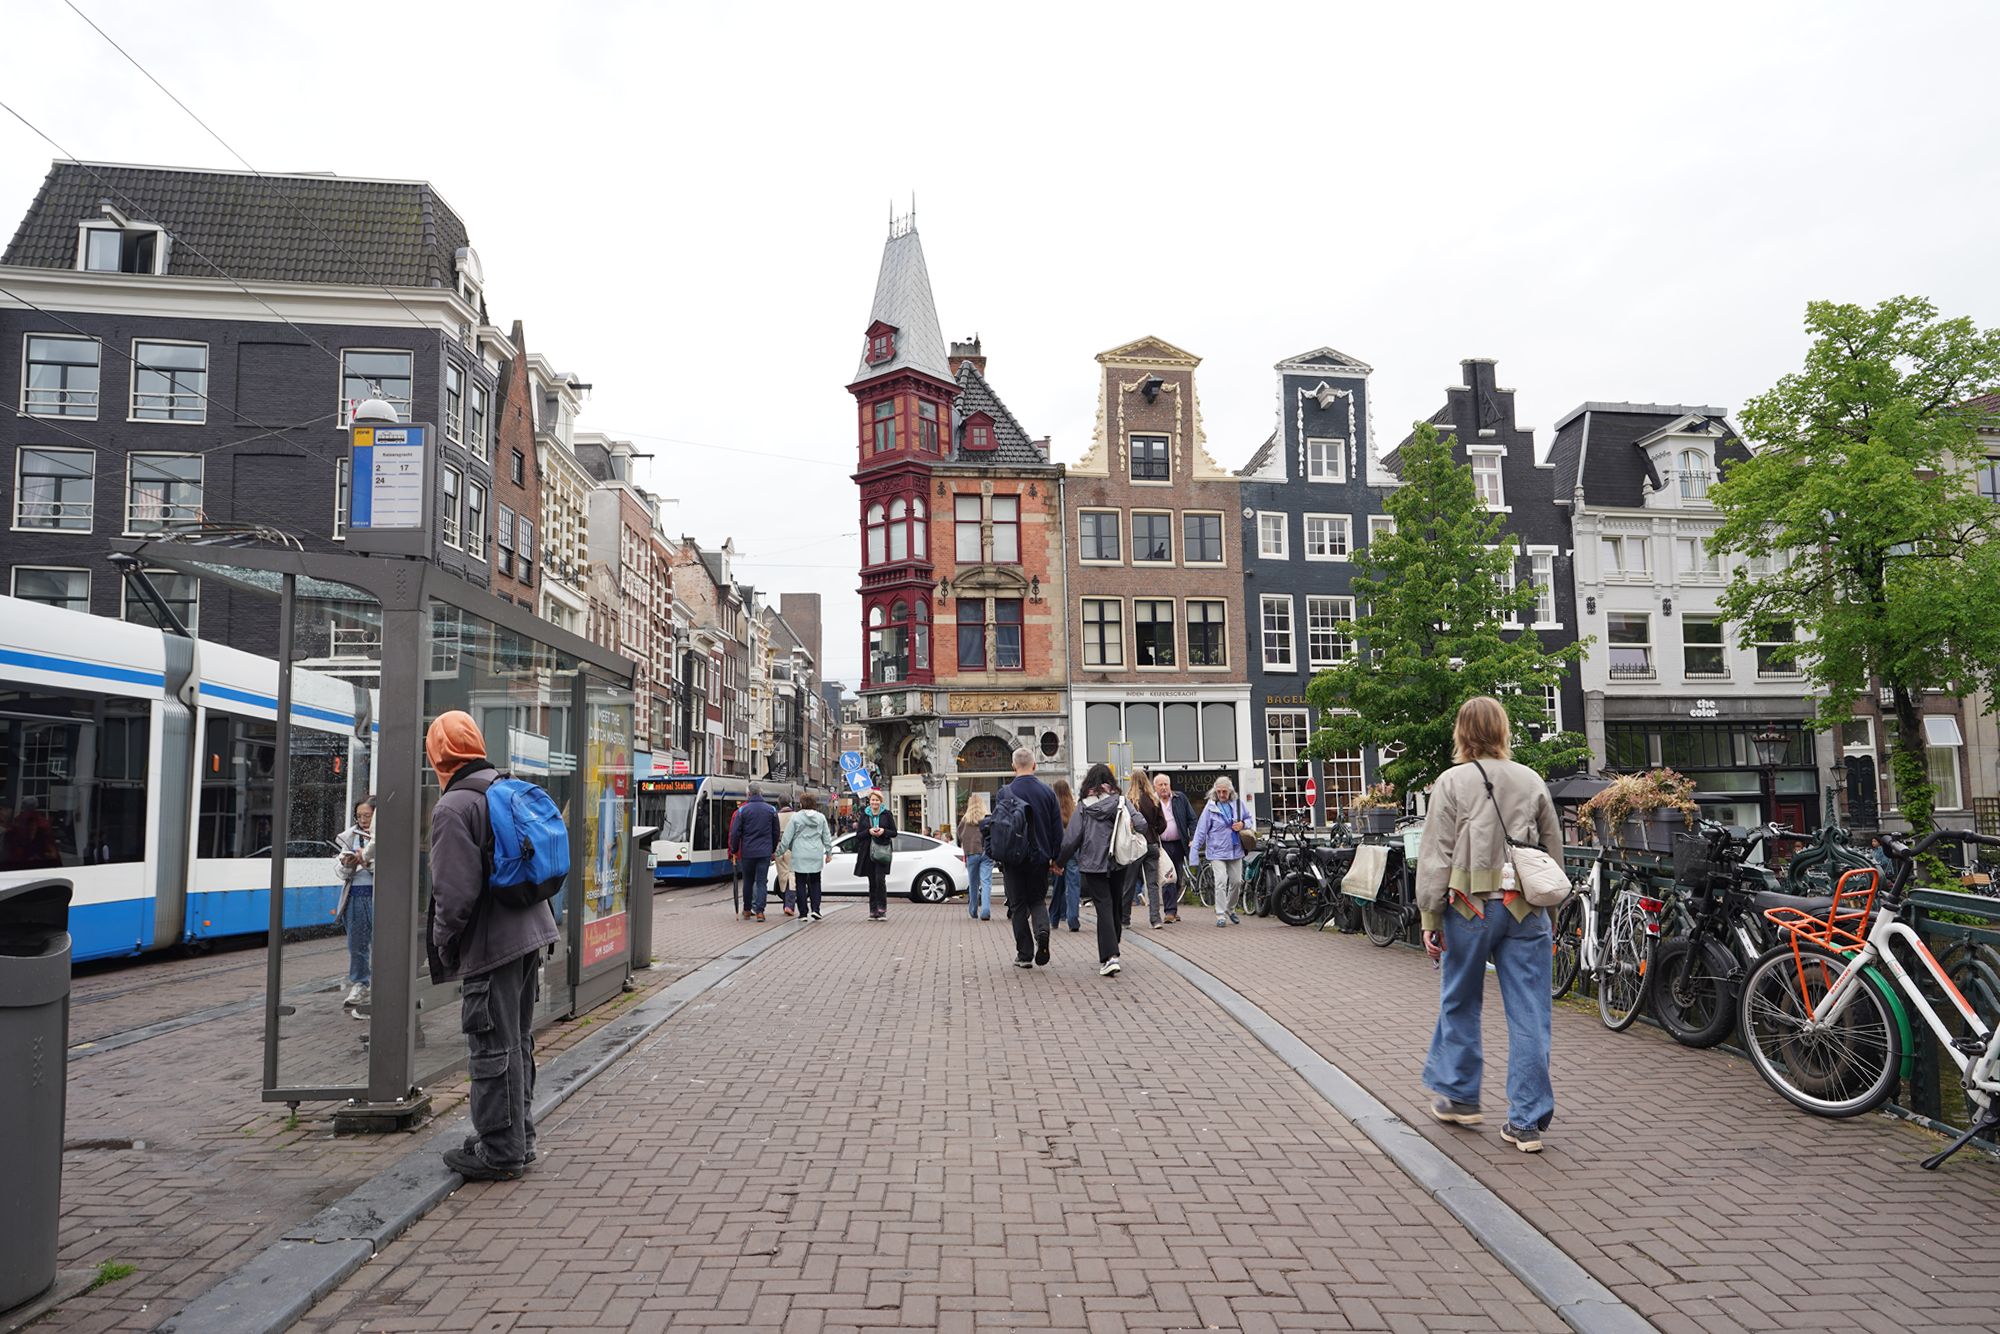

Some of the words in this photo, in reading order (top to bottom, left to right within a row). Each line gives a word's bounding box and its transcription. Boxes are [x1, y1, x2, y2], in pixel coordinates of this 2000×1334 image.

[1696, 699, 1715, 708] the
[1690, 708, 1719, 717] color
[599, 710, 610, 723] MEET
[611, 713, 620, 726] THE
[589, 727, 606, 743] DUTCH
[606, 732, 625, 746] MASTERS
[641, 782, 649, 790] 24
[653, 782, 673, 790] Centraal
[675, 781, 694, 790] Station
